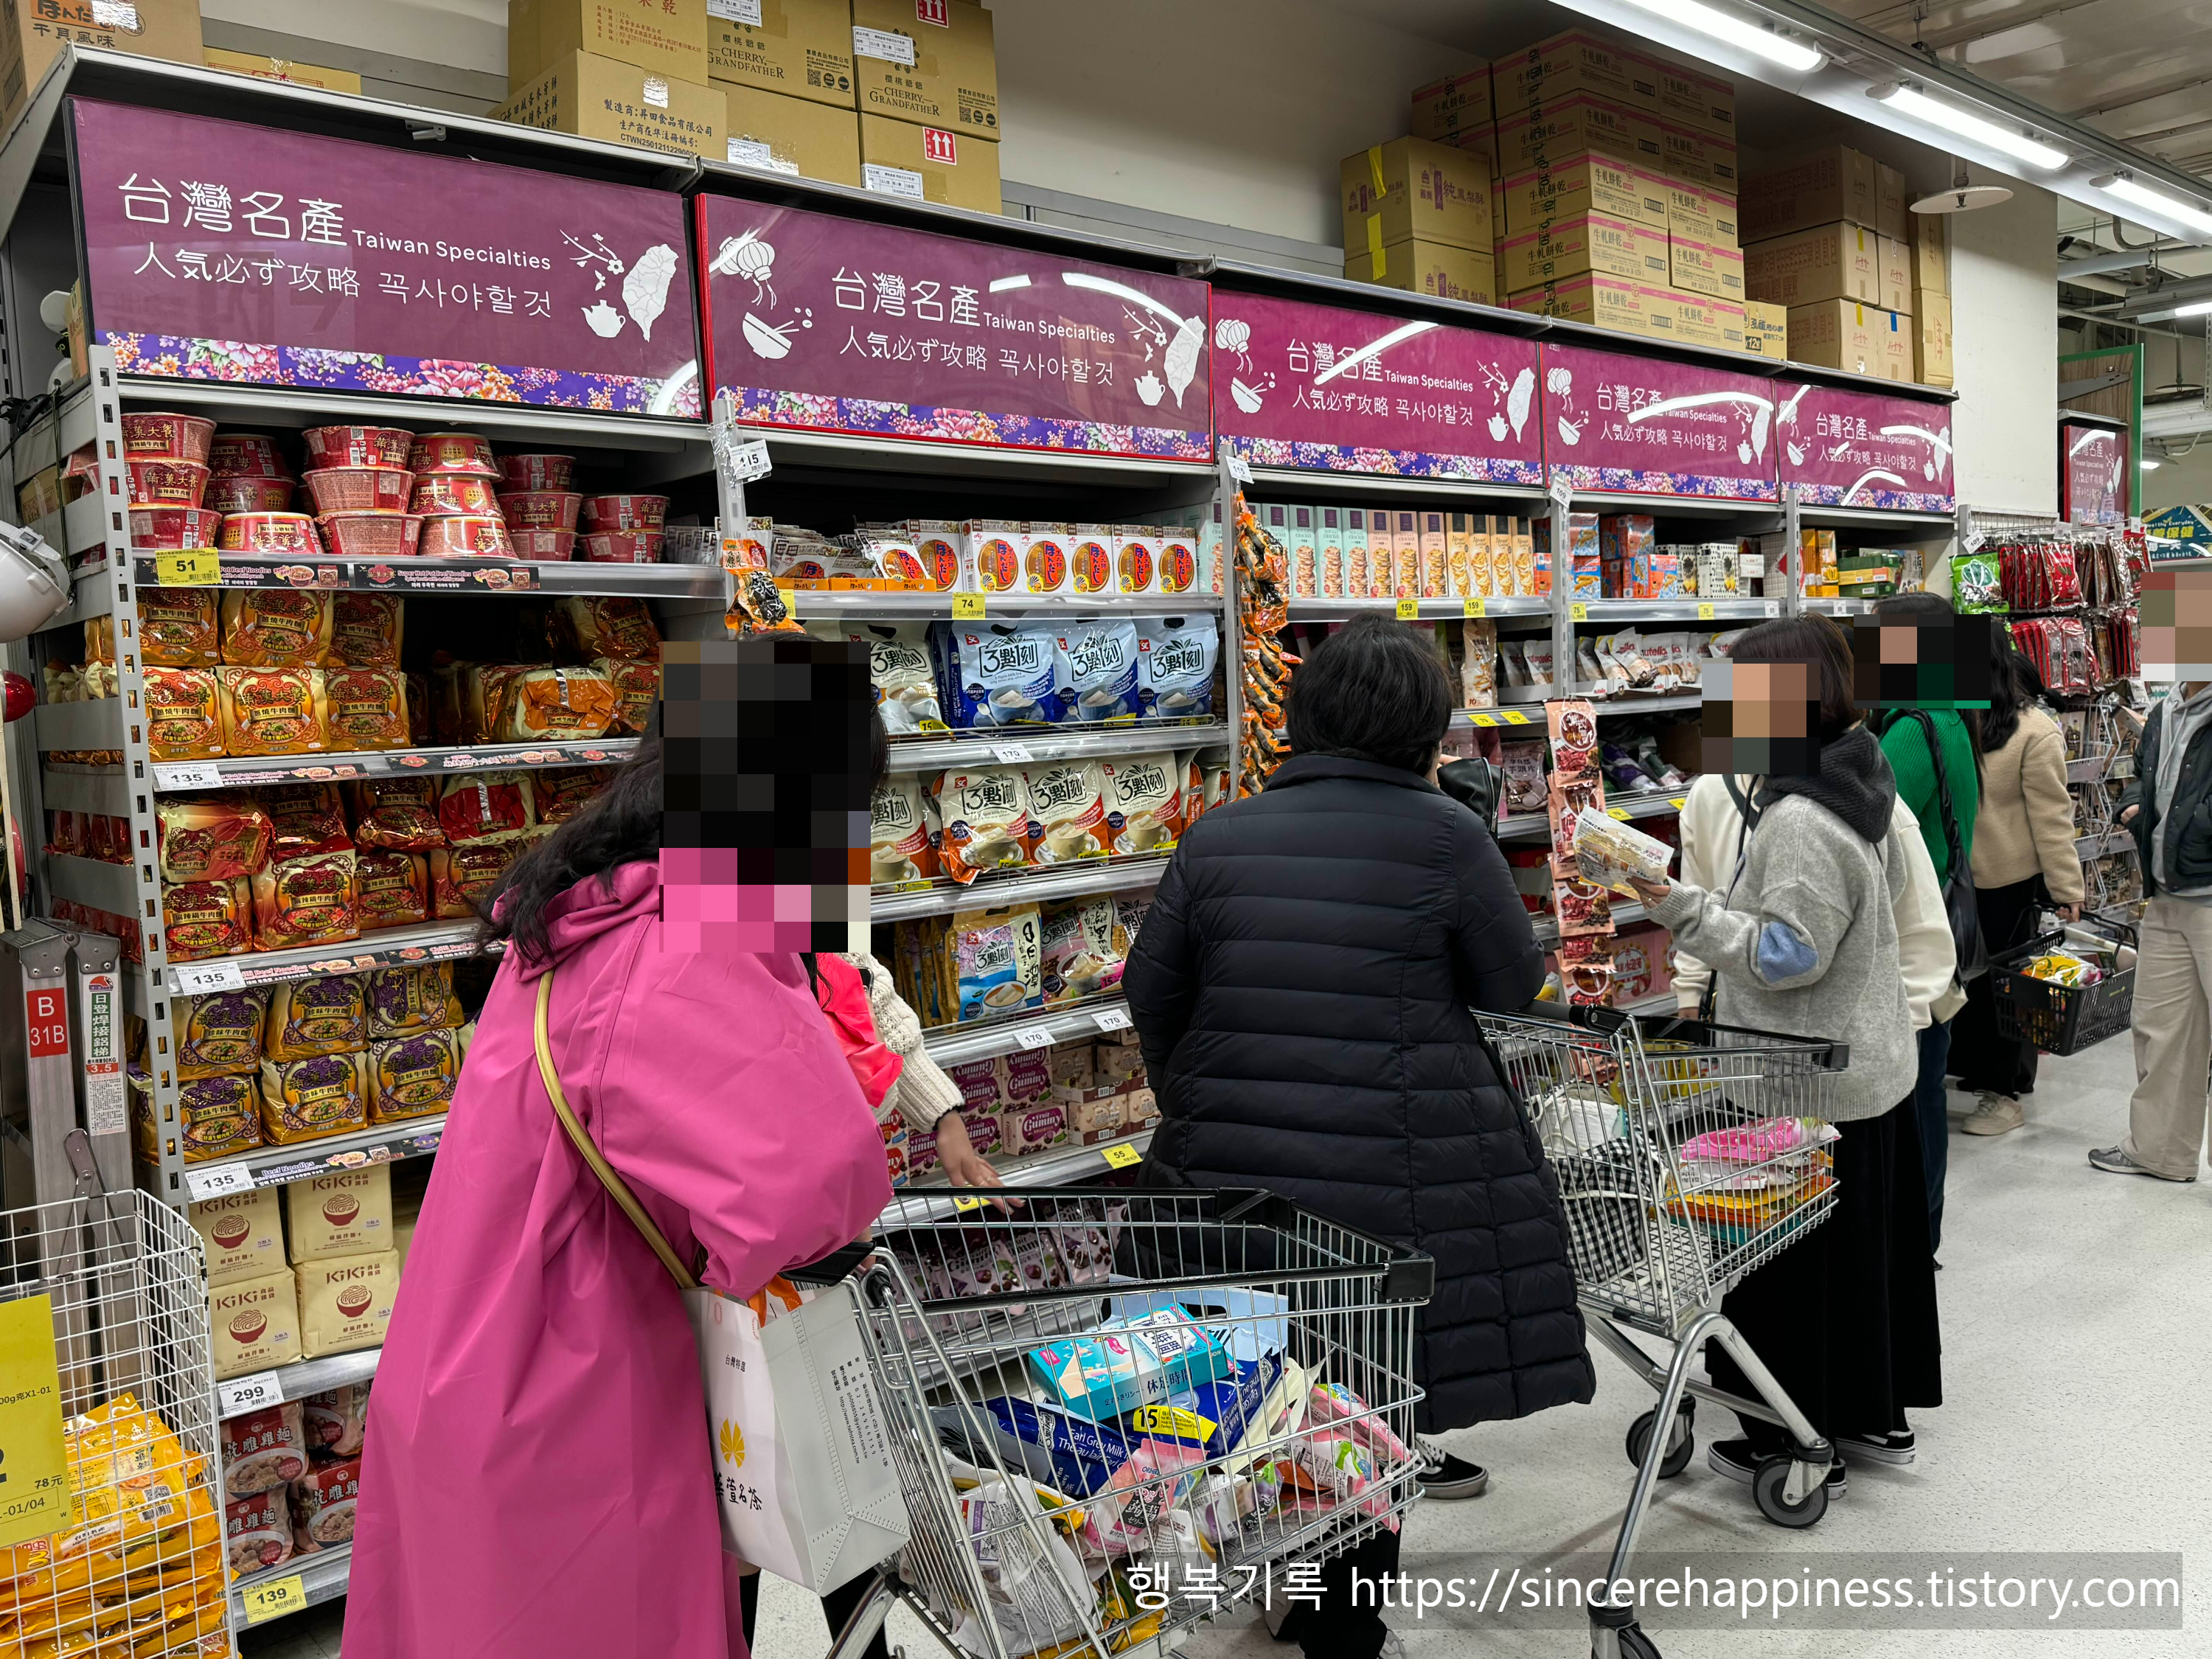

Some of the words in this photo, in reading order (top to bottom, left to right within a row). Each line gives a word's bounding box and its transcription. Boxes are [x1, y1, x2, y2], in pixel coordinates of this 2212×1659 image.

[33, 24, 115, 48] 干貝風味
[721, 46, 765, 64] CHERRY
[708, 52, 785, 79] GRANDFATHER
[869, 90, 940, 117] GRANDFATHER
[884, 86, 923, 103] CHERRY
[1595, 167, 1622, 188] 牛軋餅乾
[118, 173, 347, 247] 台灣名產
[1671, 191, 1697, 210] 牛軋餅乾
[1593, 228, 1623, 247] 牛軋餅乾
[352, 230, 430, 255] Taiwan
[436, 240, 551, 271] Specialties
[1675, 248, 1702, 266] 牛軋餅乾
[133, 242, 361, 299] 人気必ず攻略
[832, 266, 981, 327] 台灣名產
[1599, 290, 1628, 307] 牛軋餅乾
[983, 313, 1034, 333] Taiwan
[1038, 320, 1116, 344] Specialties
[839, 325, 988, 372] 人気必ず攻略
[1385, 369, 1420, 386] Taiwan
[1421, 374, 1474, 392] Specialties
[1292, 384, 1389, 417] 人気必ず攻略
[1689, 410, 1727, 423] Specialties
[1816, 411, 1868, 441] 台灣名產
[1600, 420, 1668, 446] 人気必ず攻略
[1888, 434, 1916, 445] Specialties
[1232, 465, 1245, 476] 115
[1556, 487, 1567, 499] 109
[1969, 538, 1981, 546] 109
[176, 560, 196, 573] 51
[936, 542, 947, 585] ほんだし
[997, 543, 1008, 582] ほんだし
[1046, 544, 1055, 582] ほんだし
[1091, 546, 1100, 584] ほんだし
[397, 570, 415, 578] Super
[250, 595, 319, 619] 滿漢大餐
[961, 599, 973, 608] 74
[1401, 603, 1413, 611] 159
[1573, 606, 1581, 614] 75
[983, 644, 1034, 673] 3點1刻
[1073, 644, 1119, 675] 3點1刻
[1641, 646, 1668, 656] nutella
[1153, 648, 1200, 678] 3點1刻
[238, 685, 306, 706] 滿漢大餐
[329, 685, 394, 702] 滿漢大餐
[1001, 750, 1020, 758] 170
[170, 773, 204, 783] 135
[1119, 772, 1163, 801] 3點1刻
[967, 783, 1014, 810] 3點1刻
[1034, 779, 1082, 810] 3點1刻
[872, 799, 908, 824] 點1刻
[281, 874, 348, 895] 滿漢大餐
[977, 950, 1010, 969] 3點1刻
[193, 973, 225, 984] 135
[38, 996, 55, 1017] B
[296, 989, 362, 1006] 滿漢大餐
[197, 1009, 261, 1026] 滿漢大餐
[1103, 1016, 1120, 1025] 170
[30, 1025, 65, 1046] 31B
[1025, 1033, 1043, 1043] 170
[91, 1064, 112, 1073] 3.5
[383, 1048, 448, 1073] 滿漢大餐
[288, 1064, 352, 1091] 滿漢大餐
[1009, 1073, 1049, 1091] Gummy
[968, 1123, 998, 1139] ummy
[1023, 1113, 1062, 1133] Gummy
[1113, 1150, 1126, 1159] 55
[282, 1161, 316, 1173] Noodles
[203, 1174, 234, 1189] 135
[313, 1175, 352, 1192] KiKi
[199, 1196, 240, 1214] KiKi
[326, 1267, 365, 1284] KiKi
[216, 1290, 257, 1310] KiKi
[725, 1354, 746, 1372] 台灣特選
[1147, 1367, 1193, 1395] 休足時間
[234, 1385, 265, 1403] 299
[1138, 1408, 1158, 1428] 15
[226, 1425, 293, 1459] 花雕雞麵
[1106, 1443, 1124, 1459] Milk
[0, 1497, 46, 1519] -01/04
[227, 1508, 276, 1536] 雕雞麵
[257, 1587, 287, 1604] 139
